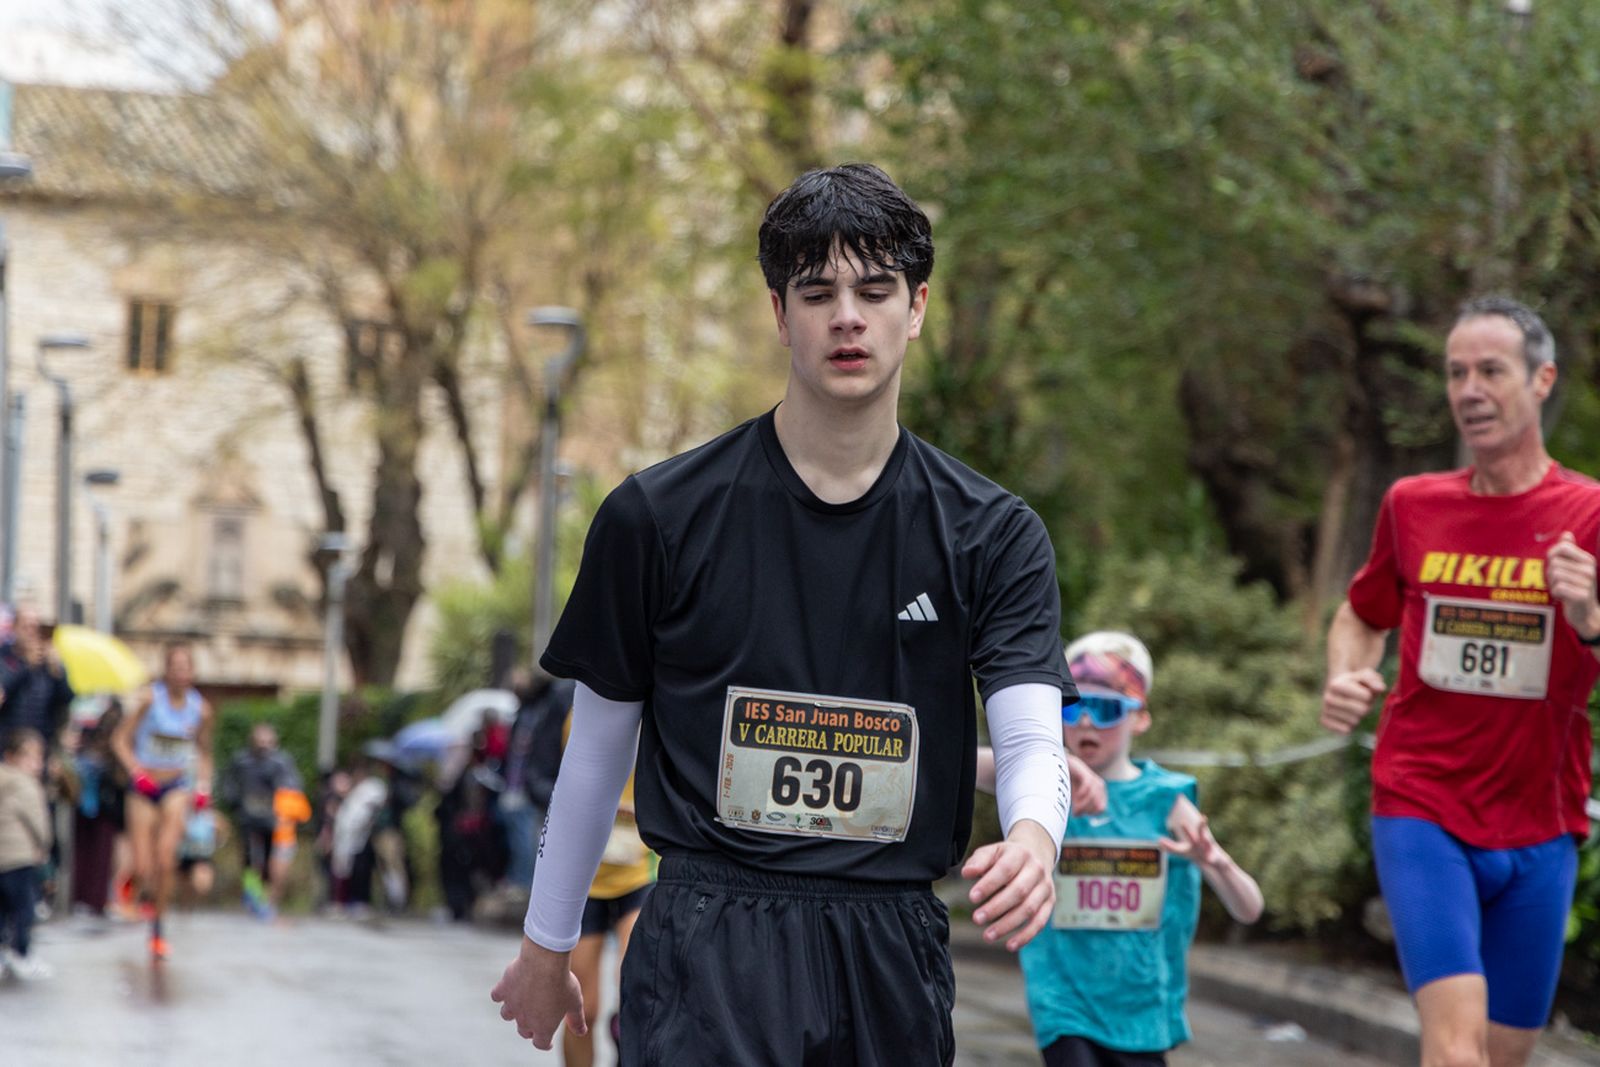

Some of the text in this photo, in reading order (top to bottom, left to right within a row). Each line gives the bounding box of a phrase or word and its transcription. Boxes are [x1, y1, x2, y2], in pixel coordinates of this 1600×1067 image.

[1419, 552, 1546, 589] BIKILA
[1462, 642, 1509, 677] 681
[745, 701, 900, 732] IES San Juan Bosco
[739, 723, 904, 757] V CARRERA POPULAR
[772, 756, 863, 812] 630
[1077, 880, 1140, 912] 1060
